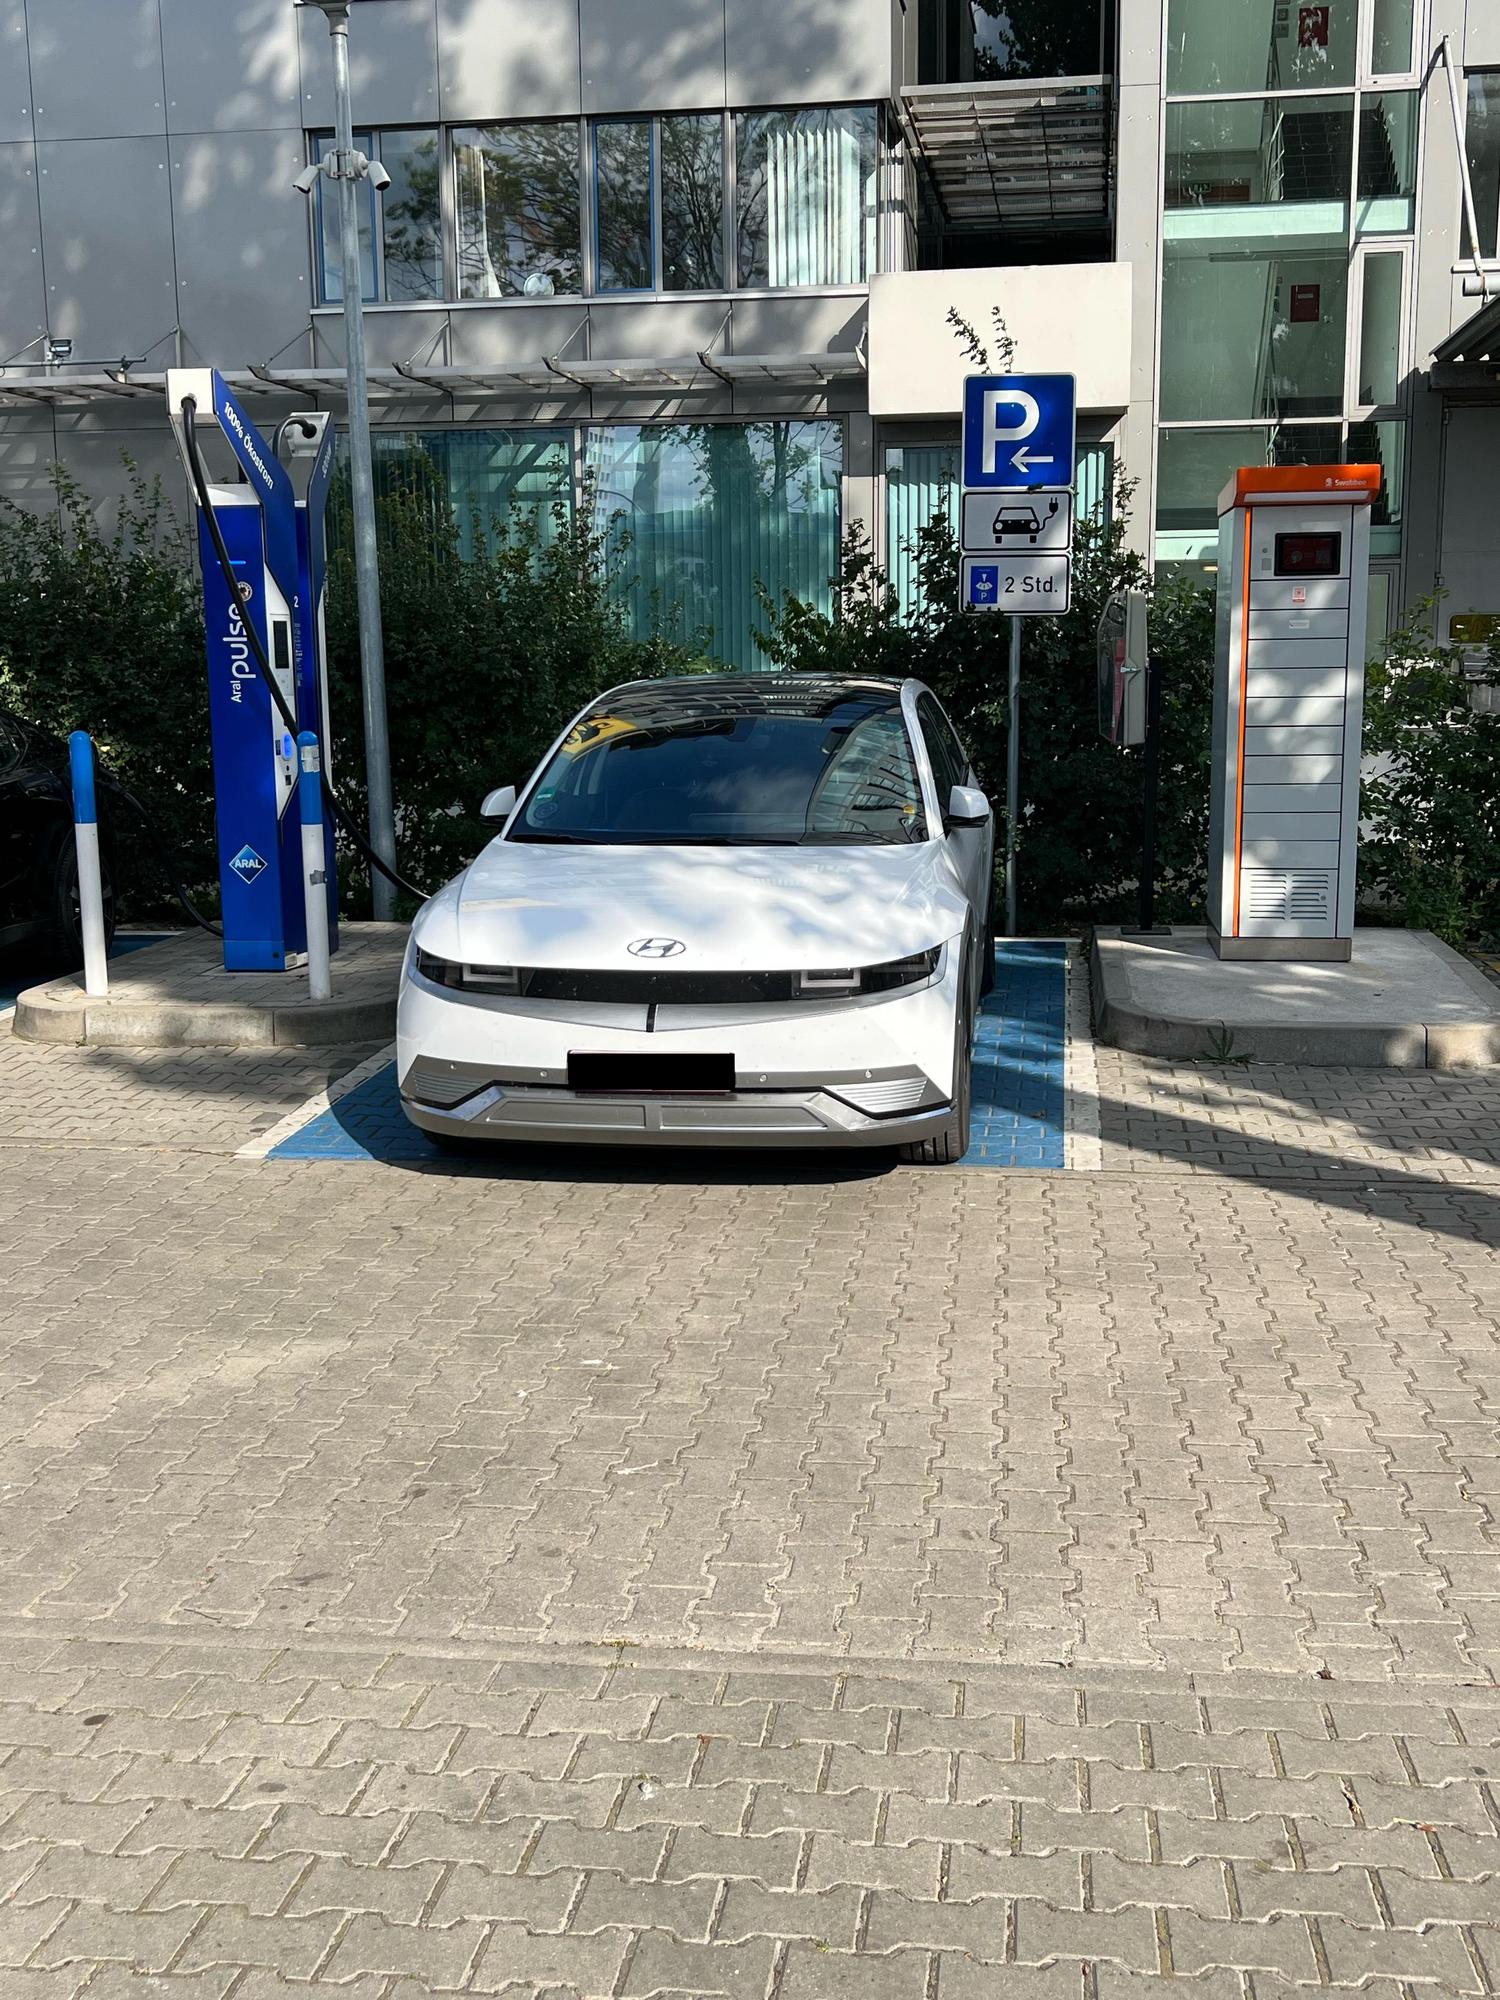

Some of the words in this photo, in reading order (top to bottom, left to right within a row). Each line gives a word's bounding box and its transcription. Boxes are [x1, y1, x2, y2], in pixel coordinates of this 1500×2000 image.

[982, 390, 1040, 474] P
[224, 401, 244, 439] 100%
[243, 432, 274, 490] Ökostrom
[1004, 576, 1015, 593] 2
[1022, 575, 1058, 593] Std.
[293, 595, 299, 608] 2
[230, 680, 242, 703] Aral
[234, 859, 262, 868] ARAL
